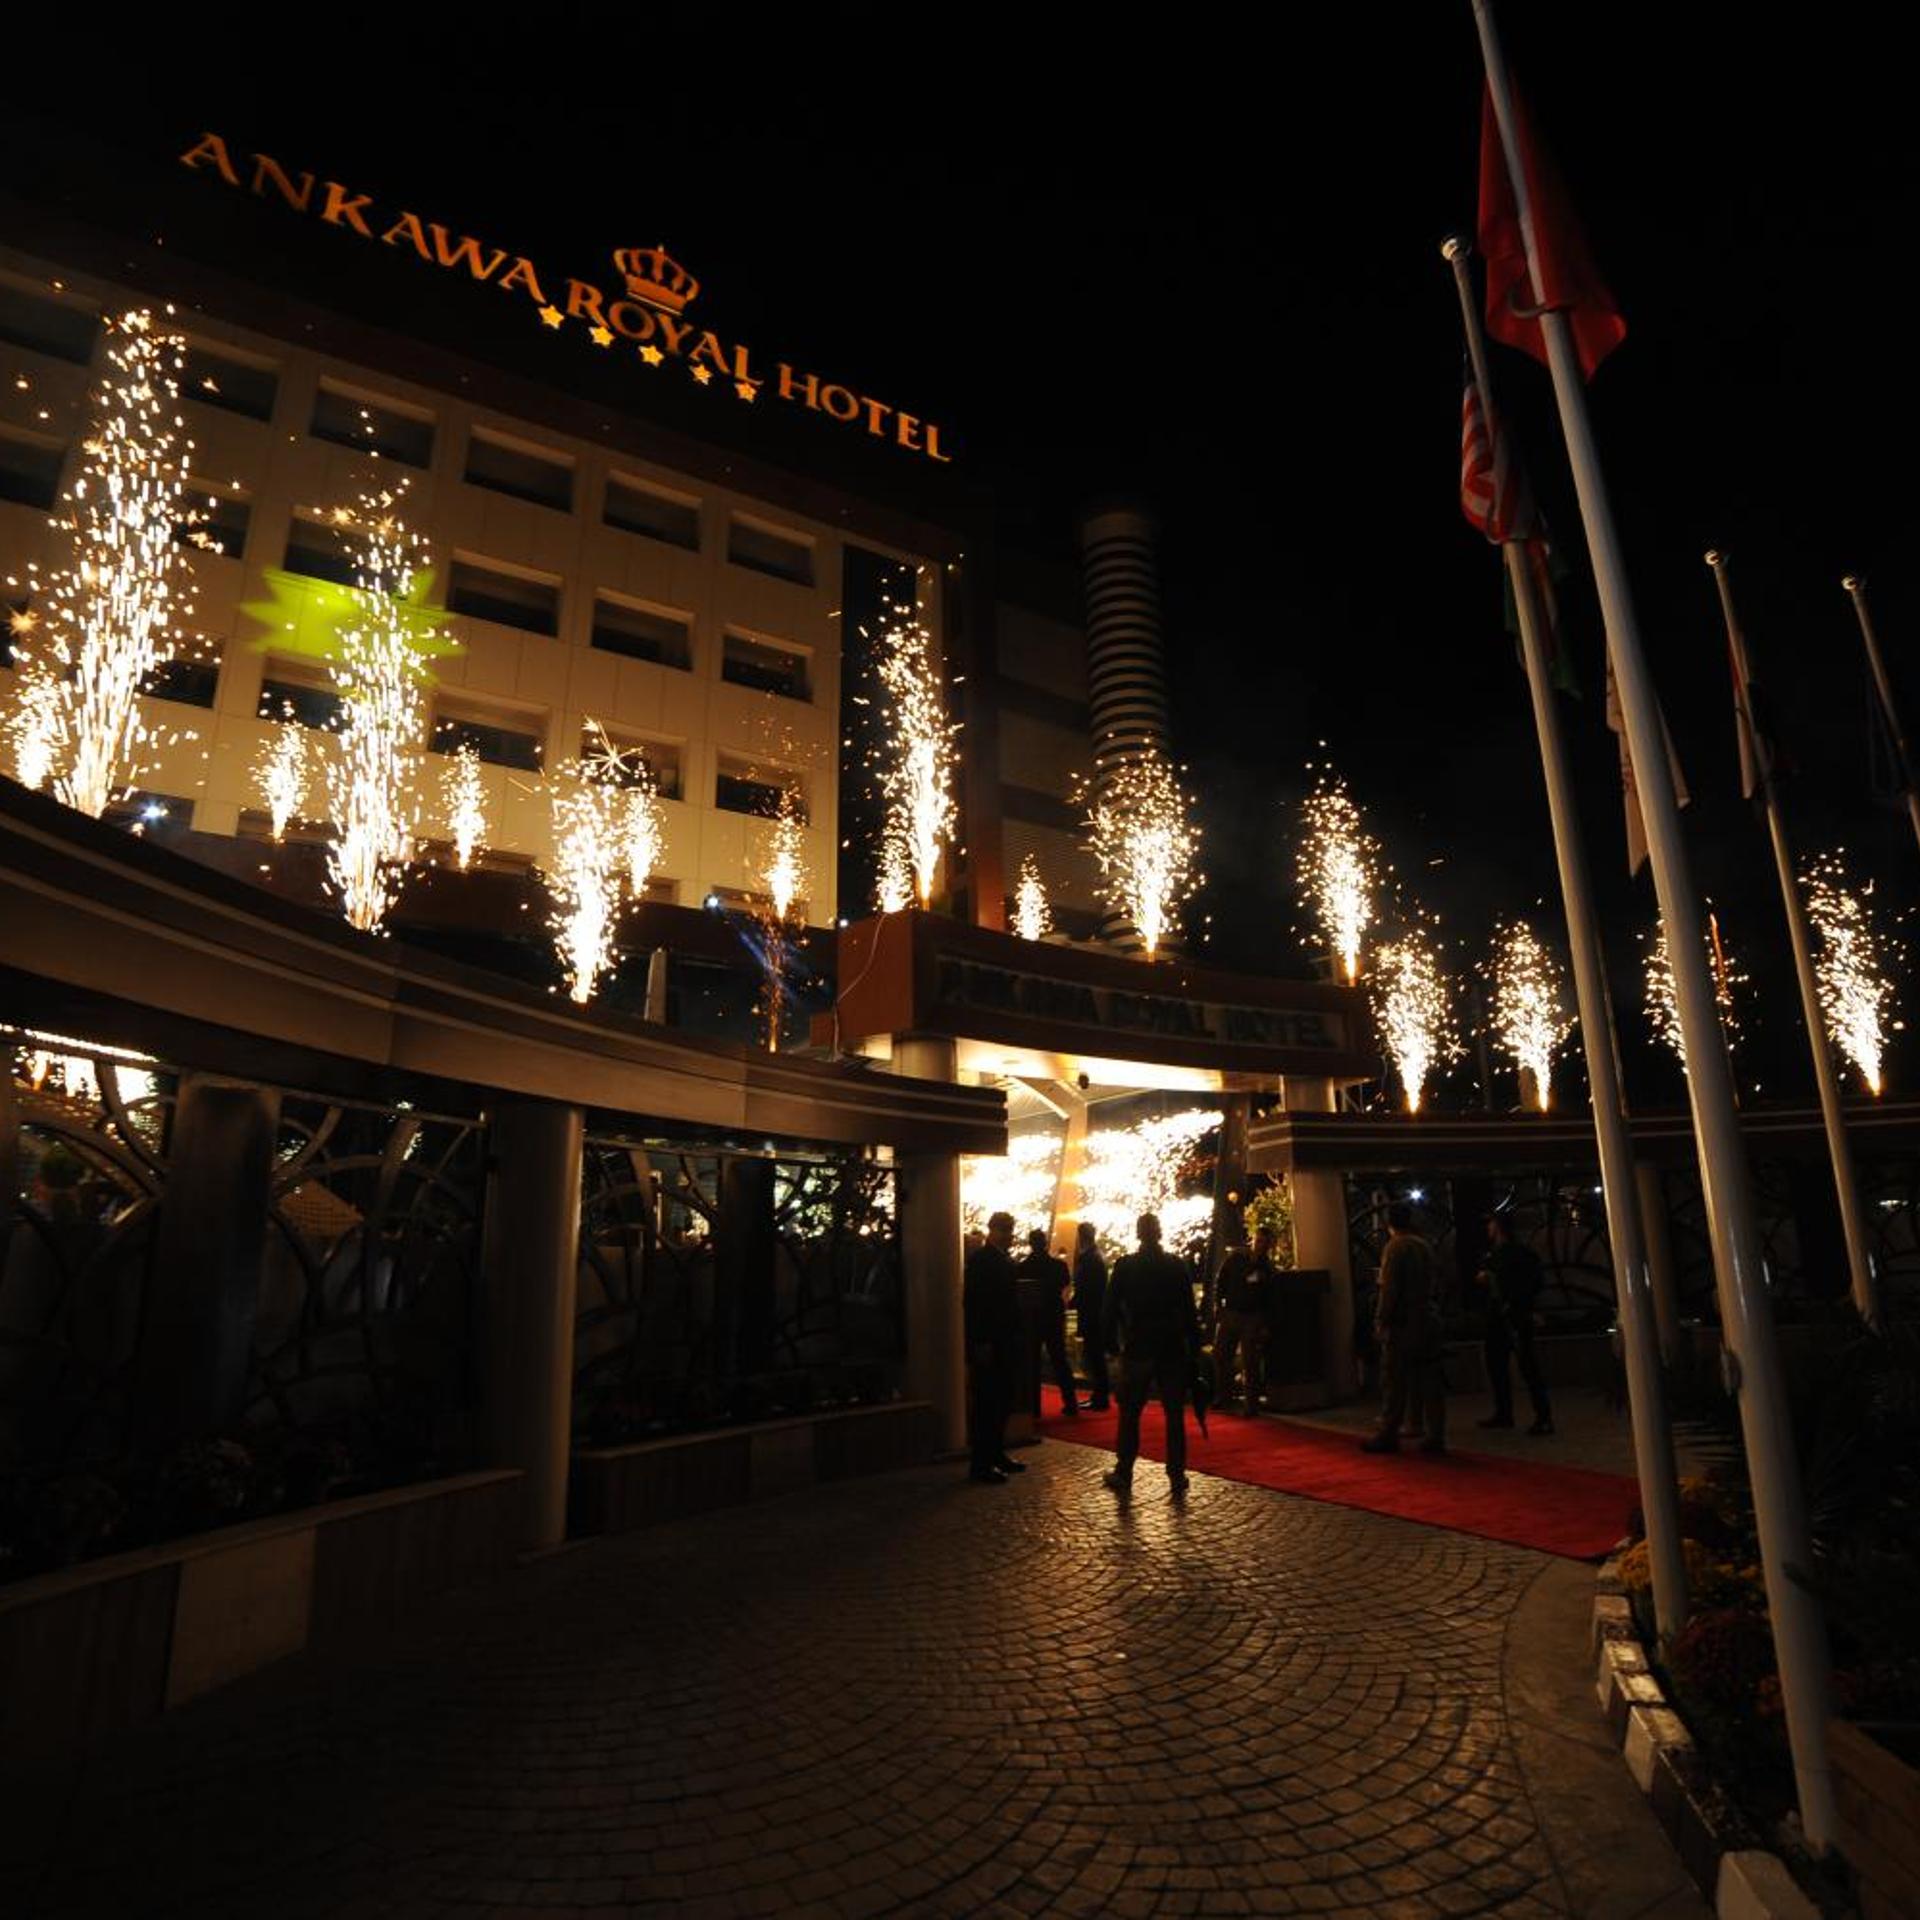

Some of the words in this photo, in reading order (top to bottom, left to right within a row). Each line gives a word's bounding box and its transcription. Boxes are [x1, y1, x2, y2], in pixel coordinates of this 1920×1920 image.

[180, 132, 546, 304] ANKAWA
[566, 278, 765, 386] ROYAL
[778, 363, 952, 462] HOTEL
